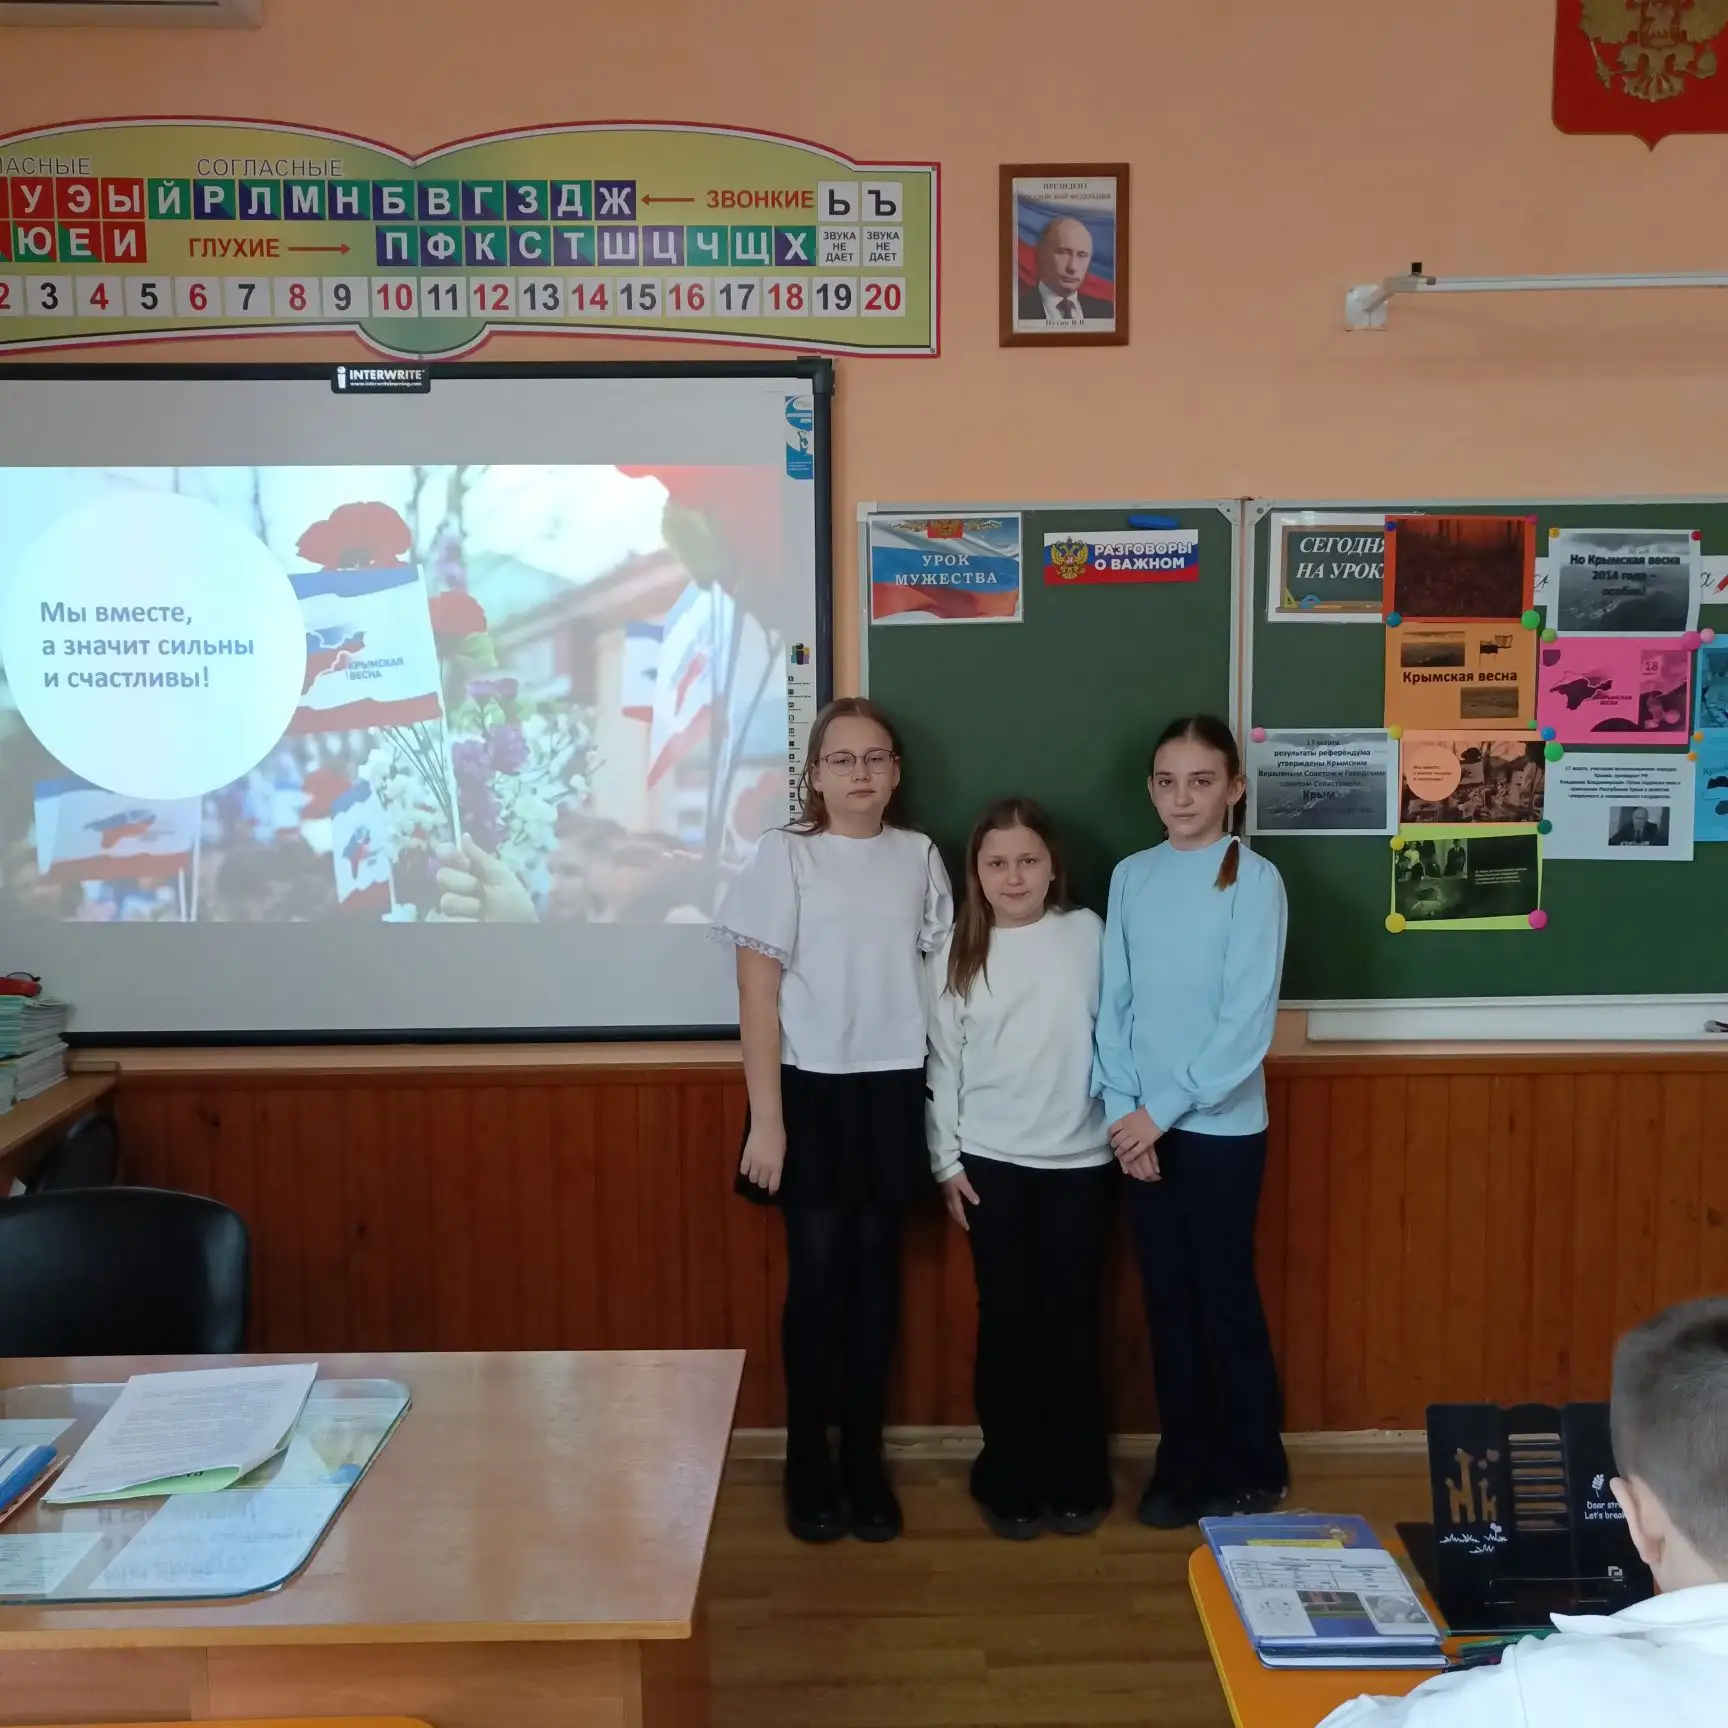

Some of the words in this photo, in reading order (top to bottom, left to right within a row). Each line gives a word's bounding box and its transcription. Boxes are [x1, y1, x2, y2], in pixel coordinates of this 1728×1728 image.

[0, 157, 91, 175] АСНЫЕ
[197, 158, 344, 177] СОГЛАСНЫЕ
[20, 185, 43, 213] У
[67, 184, 91, 213] Э
[108, 184, 140, 213] Ы
[157, 180, 181, 215] Й
[204, 186, 225, 214] Р
[247, 186, 271, 215] Л
[293, 186, 319, 214] М
[337, 186, 359, 214] Н
[382, 186, 406, 214] Б
[428, 187, 451, 215] В
[474, 186, 493, 214] Г
[517, 186, 539, 215] З
[557, 185, 584, 217] Д
[600, 186, 632, 215] Ж
[706, 190, 814, 209] ЗВОНКИЕ
[824, 231, 856, 240] ЗВУКА
[867, 231, 899, 240] ЗВУКА
[17, 227, 52, 255] Ю
[69, 228, 91, 256] Е
[114, 229, 137, 257] И
[189, 238, 280, 258] ГЛУХИЕ
[386, 233, 408, 260] П
[426, 231, 456, 260] Ф
[475, 232, 496, 260] К
[518, 232, 542, 260] С
[563, 233, 585, 260] Т
[603, 232, 635, 259] Ш
[653, 232, 676, 264] Ц
[696, 232, 718, 258] Ч
[736, 232, 769, 264] Щ
[784, 232, 807, 260] Х
[832, 242, 846, 251] НЕ
[876, 242, 890, 251] НЕ
[826, 252, 854, 263] ДАЕТ
[869, 252, 896, 263] ДАЕТ
[40, 283, 59, 310] 3
[90, 283, 109, 310] 4
[140, 283, 158, 310] 5
[189, 283, 208, 310] 6
[238, 283, 256, 310] 7
[289, 283, 307, 310] 8
[334, 283, 352, 310] 9
[377, 283, 413, 310] 10
[427, 283, 457, 310] 11
[473, 283, 510, 310] 12
[523, 283, 560, 310] 13
[571, 283, 609, 310] 14
[620, 283, 657, 310] 15
[668, 283, 705, 310] 16
[720, 283, 755, 310] 17
[768, 283, 804, 310] 18
[816, 283, 852, 310] 19
[864, 283, 901, 310] 20
[349, 369, 422, 380] INTERWRITE
[1094, 542, 1192, 557] РАЗГОВОРЫ
[922, 554, 970, 567] УРОК
[1095, 559, 1106, 571] О
[1111, 557, 1185, 571] ВАЖНОМ
[1570, 555, 1585, 565] Но
[1588, 554, 1645, 567] Крымская
[1648, 556, 1680, 565] весна
[1296, 562, 1324, 578] НА
[1330, 562, 1384, 579] УРОК
[1592, 570, 1618, 580] 2014
[895, 571, 998, 586] МУЖЕСТВА
[40, 602, 87, 624] Мы
[95, 604, 193, 626] вместе,
[42, 639, 56, 656] а
[63, 638, 150, 656] значит
[157, 637, 254, 656] сильны
[1645, 661, 1658, 671] 18
[44, 671, 59, 688] и
[67, 666, 209, 689] счастливы!
[350, 670, 382, 680] ВЕСНА
[1403, 671, 1473, 685] Крымская
[1478, 672, 1518, 682] весна
[1318, 749, 1371, 757] референдума
[1586, 1501, 1605, 1509] Dear
[1585, 1511, 1603, 1519] Let's
